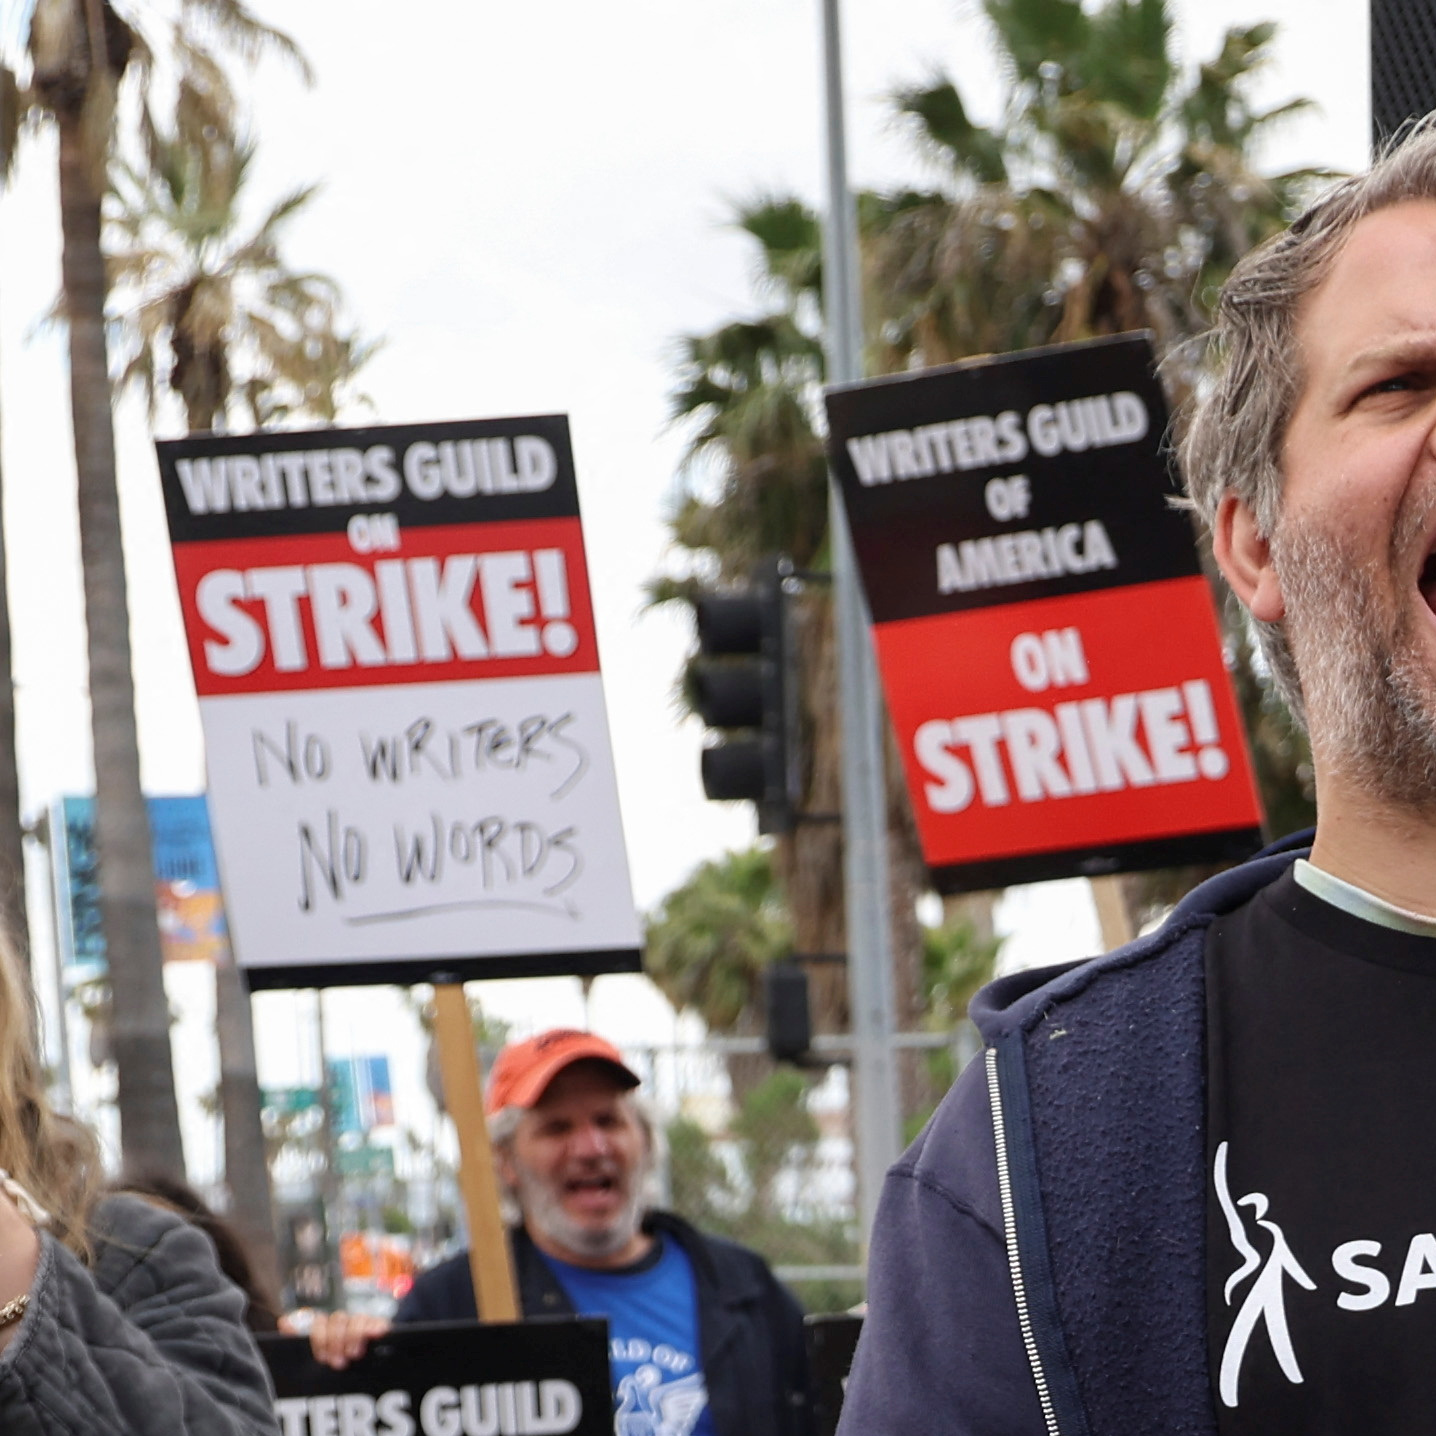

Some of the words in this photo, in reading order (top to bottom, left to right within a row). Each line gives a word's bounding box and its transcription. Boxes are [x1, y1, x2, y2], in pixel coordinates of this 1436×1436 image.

[176, 446, 398, 516] WRITERS
[403, 435, 557, 499] GUILD
[847, 411, 1025, 487] WRITERS
[1027, 391, 1149, 457] GUILD
[348, 515, 399, 552] ON
[985, 475, 1032, 522] OF
[937, 520, 1118, 595] AMERICA
[196, 549, 579, 677] STRIKE!
[1011, 628, 1088, 691] ON
[914, 679, 1229, 813] STRIKE!
[398, 814, 580, 897] WORDS
